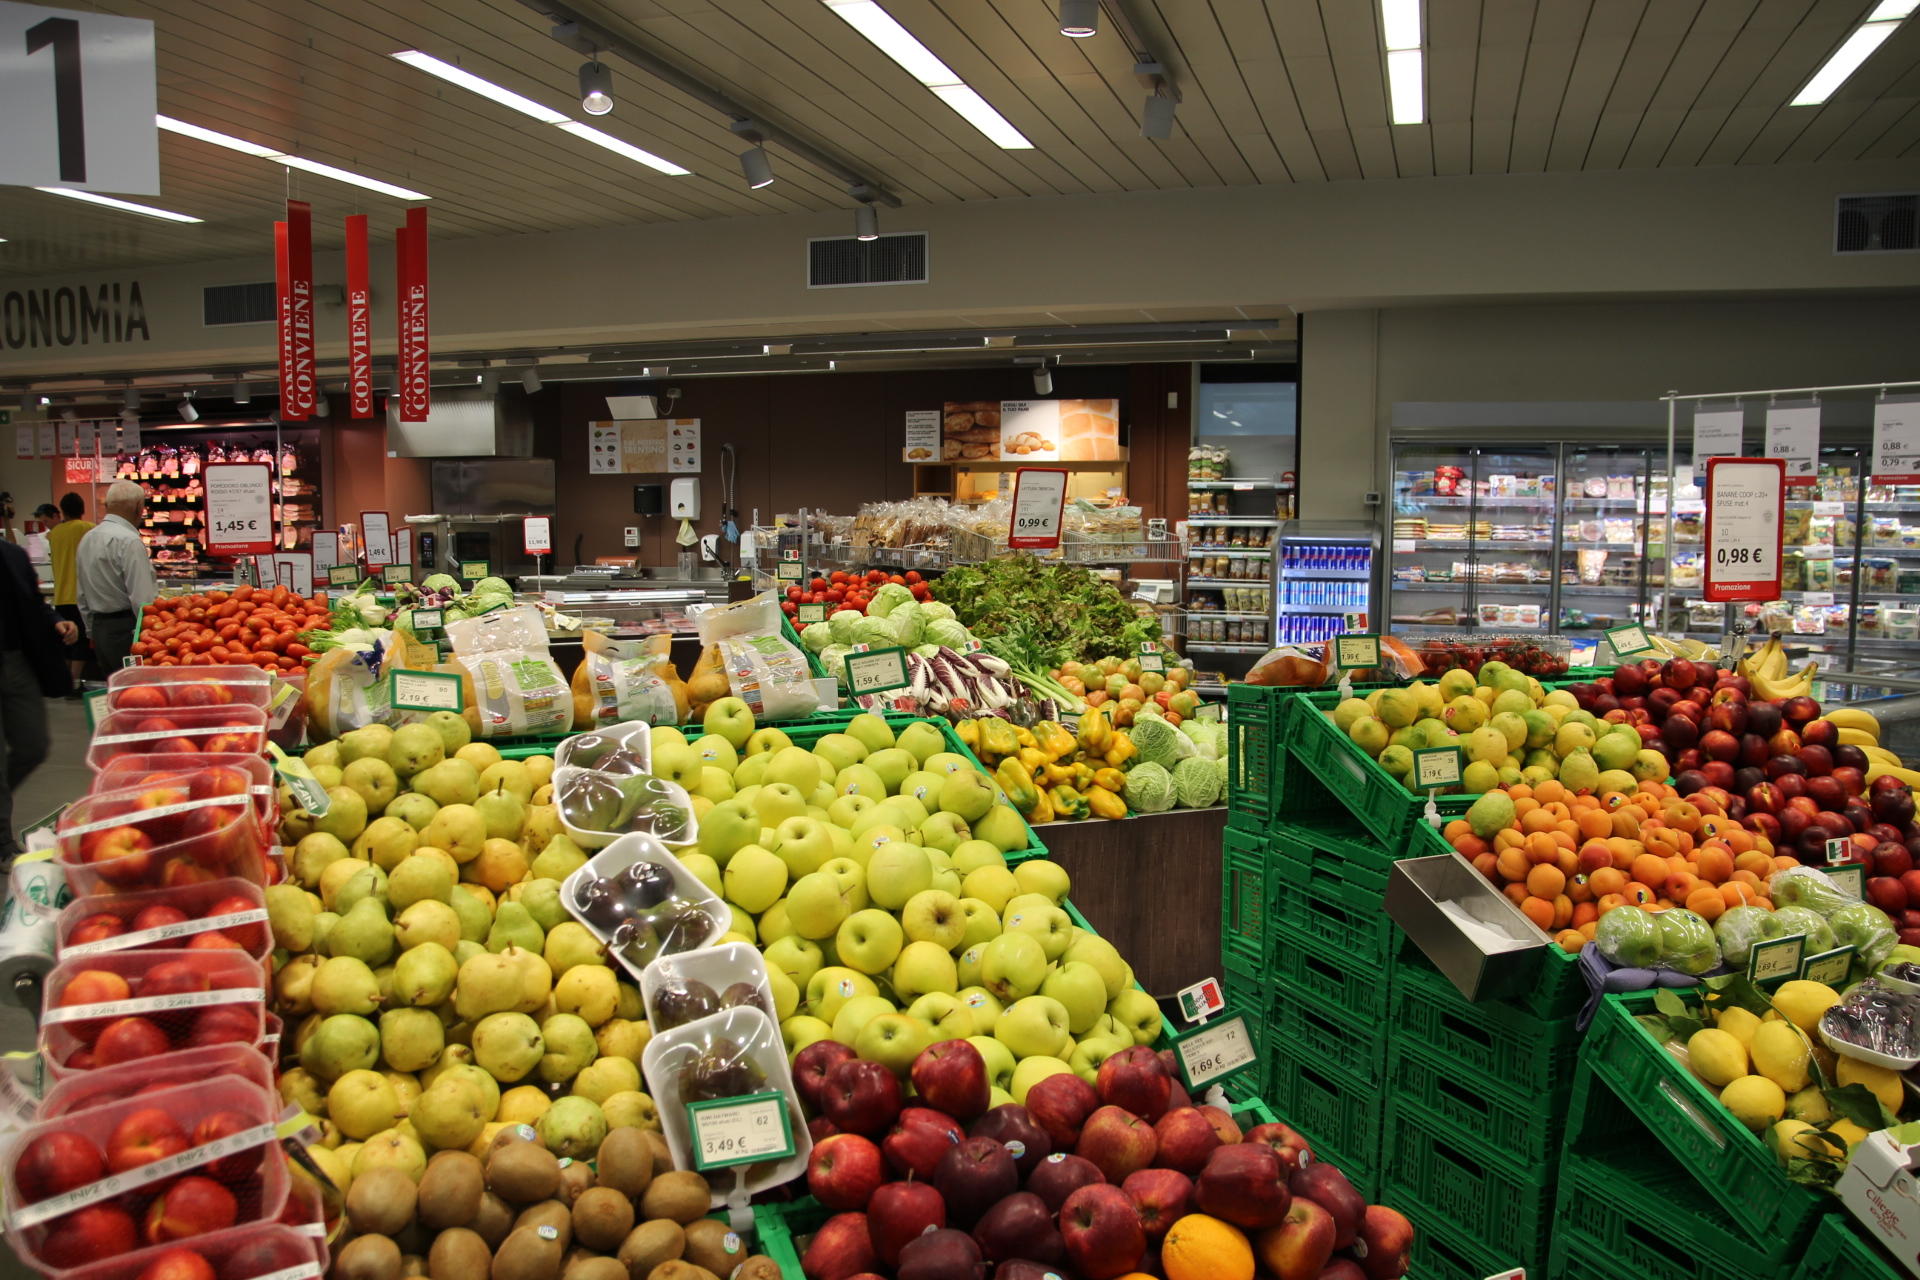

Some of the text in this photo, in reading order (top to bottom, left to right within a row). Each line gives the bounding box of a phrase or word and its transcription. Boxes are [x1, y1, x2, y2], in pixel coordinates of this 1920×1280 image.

[26, 17, 86, 183] 1
[0, 281, 150, 350] ONOMIA
[294, 280, 313, 409] CONVIENE
[352, 291, 369, 413] CONVIENE
[411, 285, 426, 411] CONVIENE
[216, 520, 257, 533] 1,45 €
[1018, 518, 1048, 528] 0,99 €
[1717, 548, 1762, 567] 0,98 €
[1714, 583, 1751, 591] Promozione
[856, 676, 873, 687] 1,59
[293, 780, 319, 811] ZANI
[161, 927, 186, 938] ZANI
[168, 999, 194, 1007] ZANI
[91, 1007, 117, 1015] ZANI
[1226, 1031, 1236, 1041] 12
[1191, 1058, 1213, 1076] 1,69
[1215, 1054, 1222, 1065] €
[756, 1115, 769, 1126] 62
[706, 1138, 734, 1154] 3,49
[738, 1136, 747, 1149] €
